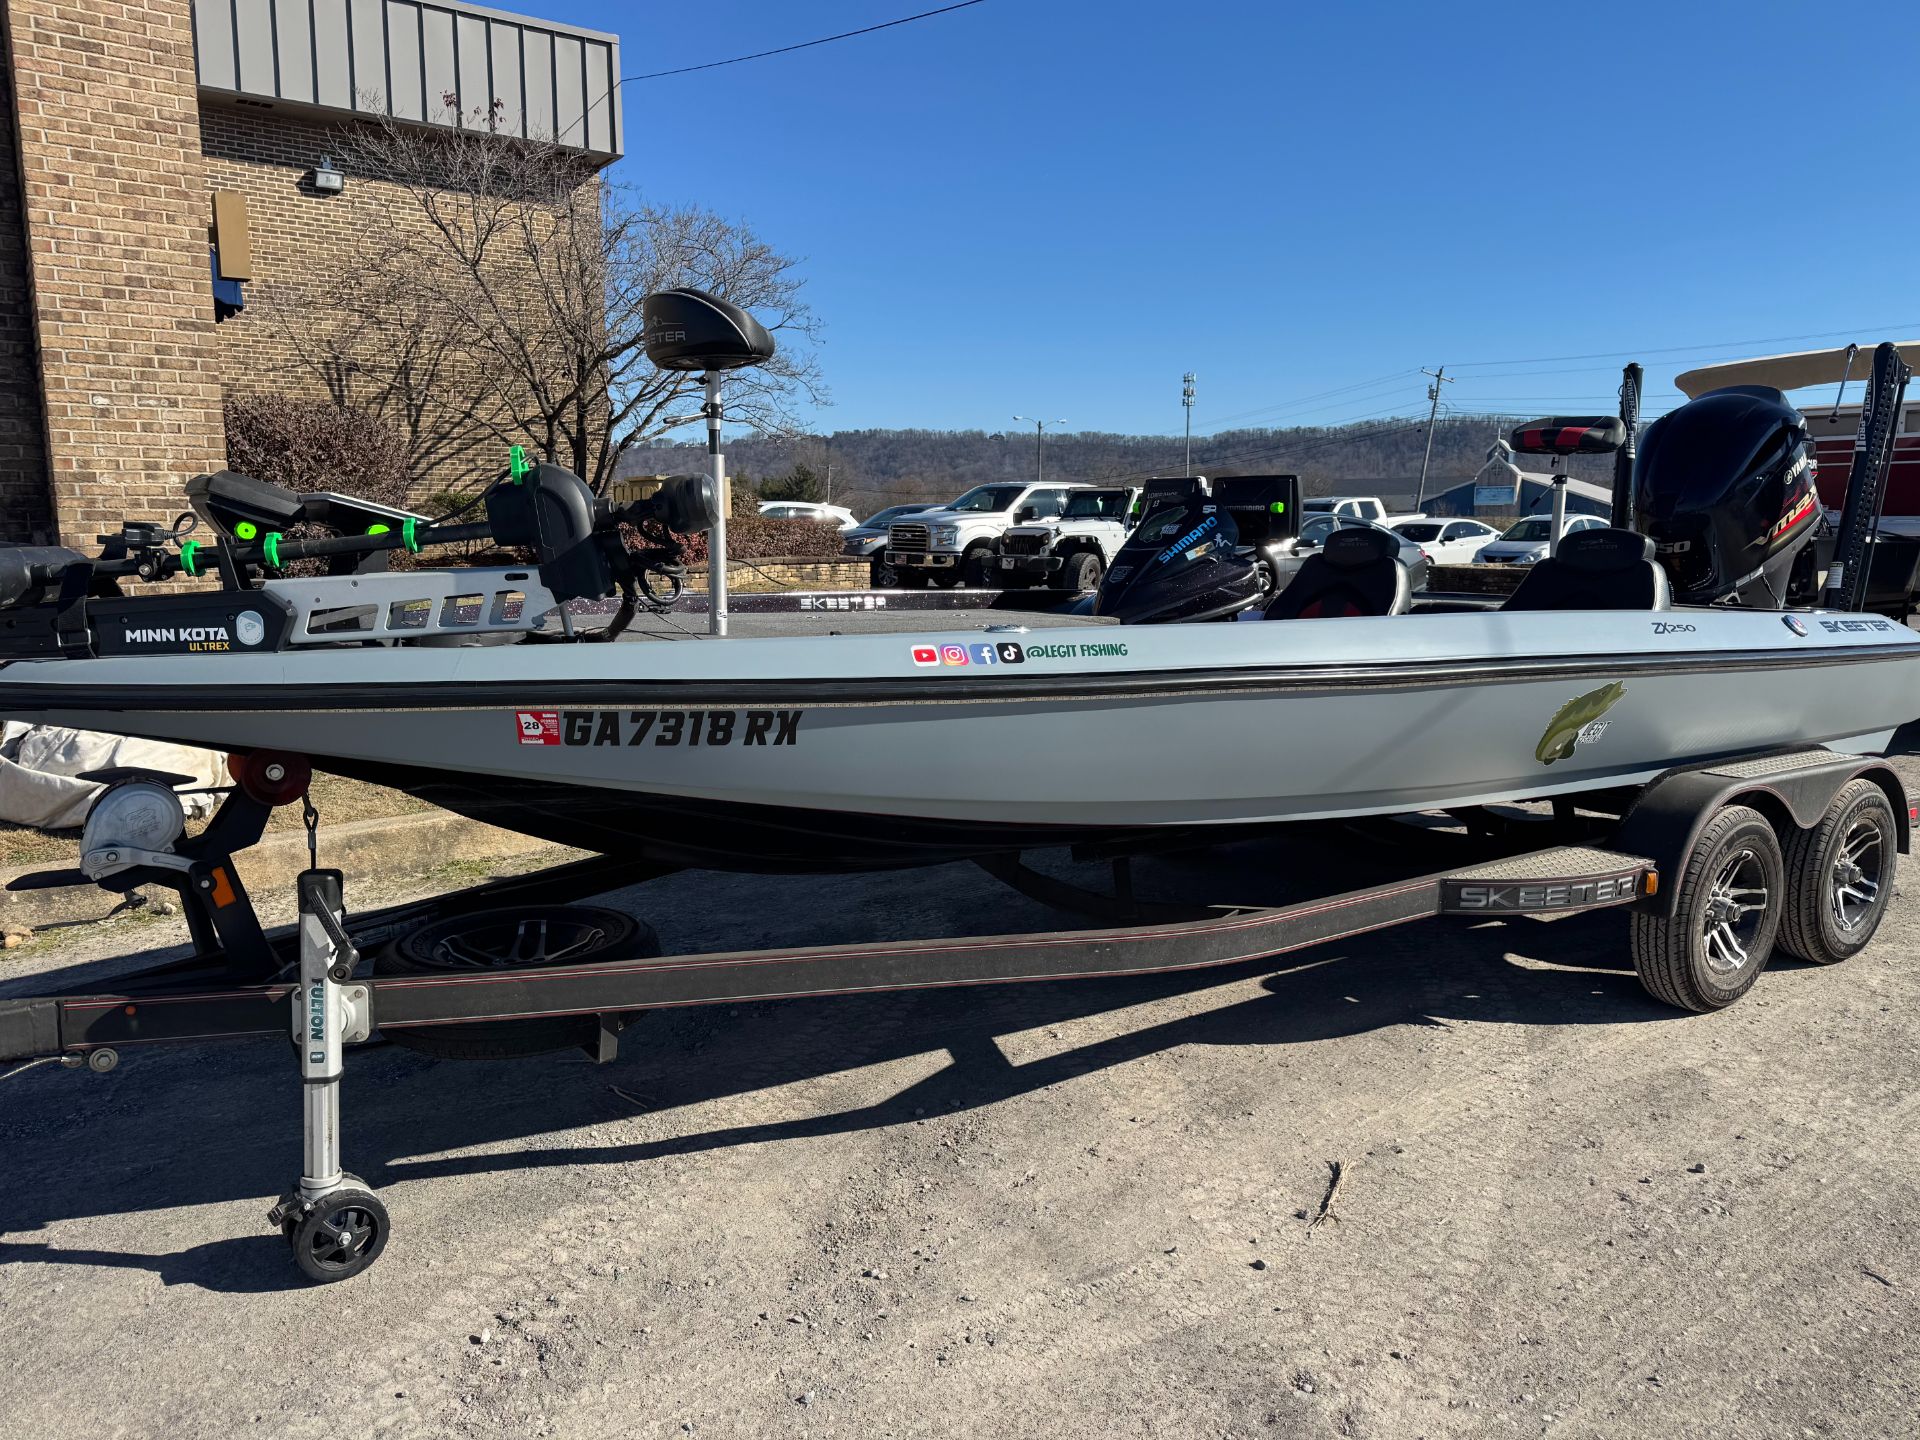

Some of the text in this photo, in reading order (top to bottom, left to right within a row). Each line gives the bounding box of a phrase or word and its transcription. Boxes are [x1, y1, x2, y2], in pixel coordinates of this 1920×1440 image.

[1626, 378, 1638, 428] POWER-POLE
[1158, 516, 1218, 565] SHIMANO
[800, 596, 886, 610] SKEETER
[1650, 621, 1697, 634] ZX250
[1818, 620, 1896, 633] SKEETER
[125, 628, 175, 643] MINN
[179, 627, 229, 642] KOTA
[189, 641, 230, 652] ULTREX
[1026, 643, 1128, 658] @LEGIT FISHING
[523, 721, 540, 730] 28
[563, 711, 620, 746] GA
[627, 710, 736, 746] 7318
[743, 710, 803, 746] RX
[1582, 720, 1613, 737] LEGIT
[1459, 875, 1636, 908] SKEETER
[310, 978, 324, 1041] FULTON
